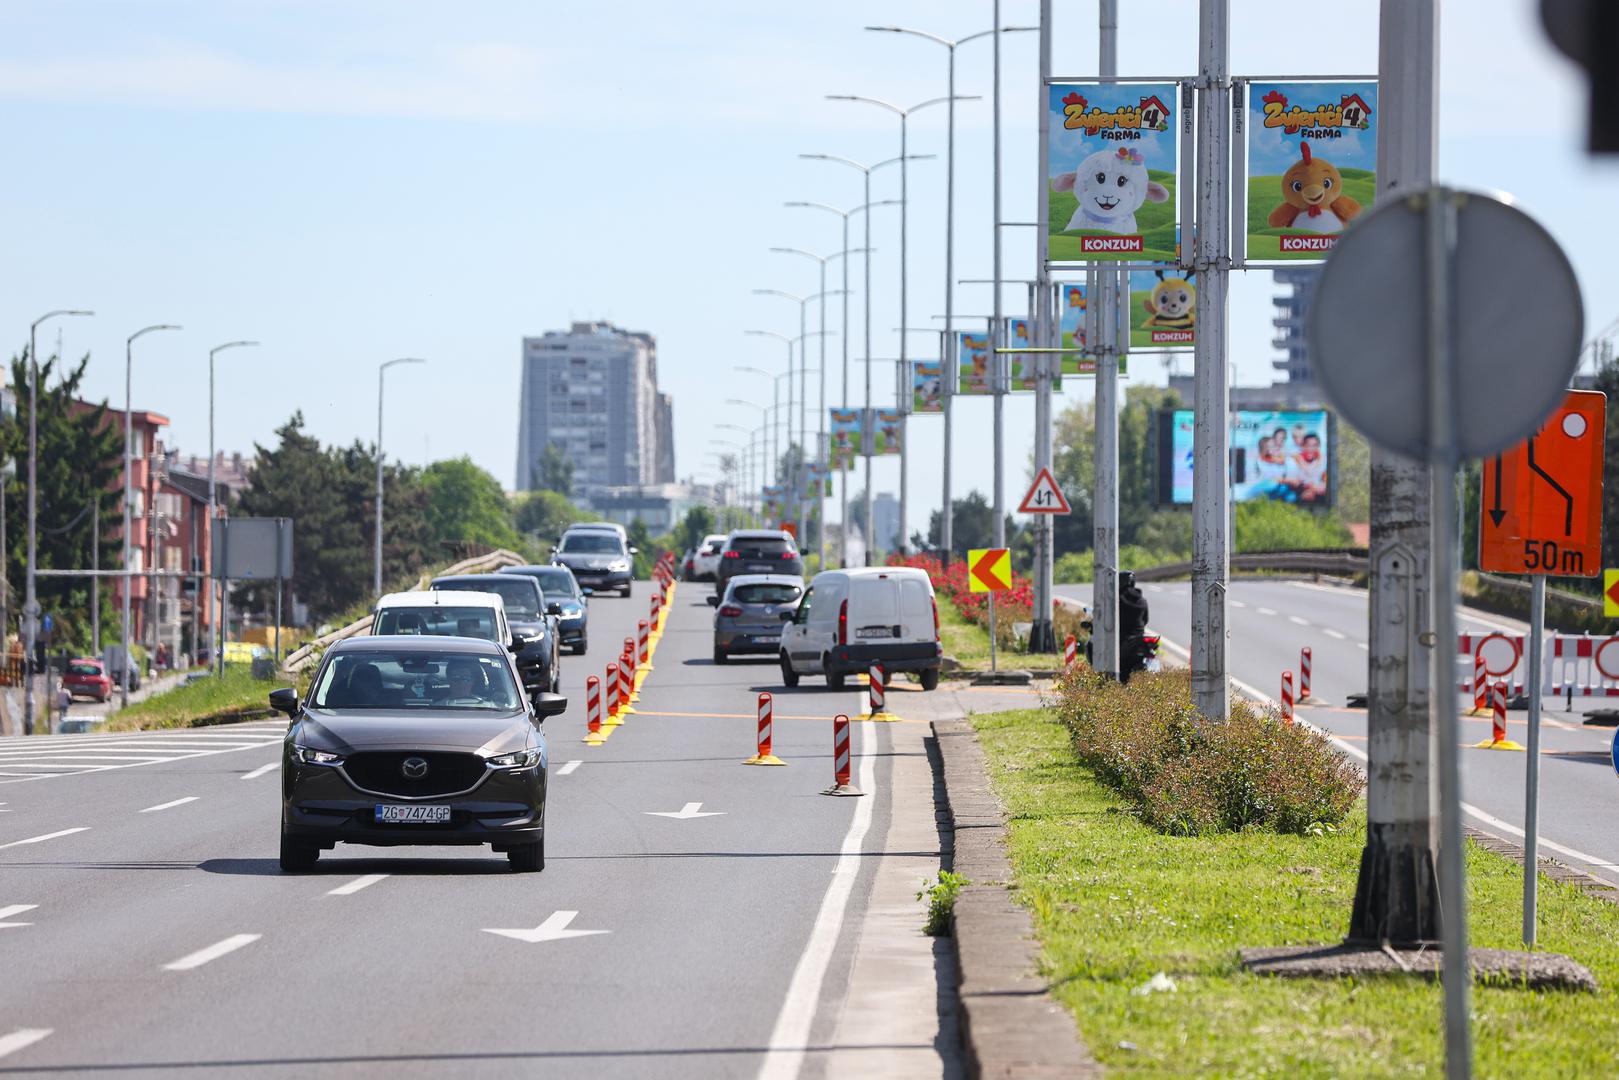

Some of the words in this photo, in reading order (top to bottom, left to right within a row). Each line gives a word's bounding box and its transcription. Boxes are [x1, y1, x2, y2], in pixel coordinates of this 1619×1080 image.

[1143, 109, 1160, 128] 4
[1344, 107, 1361, 127] 4
[1101, 129, 1141, 140] FARMA
[1301, 128, 1342, 139] FARMA
[1084, 239, 1140, 250] KONZUM
[1153, 332, 1192, 341] KONZUM
